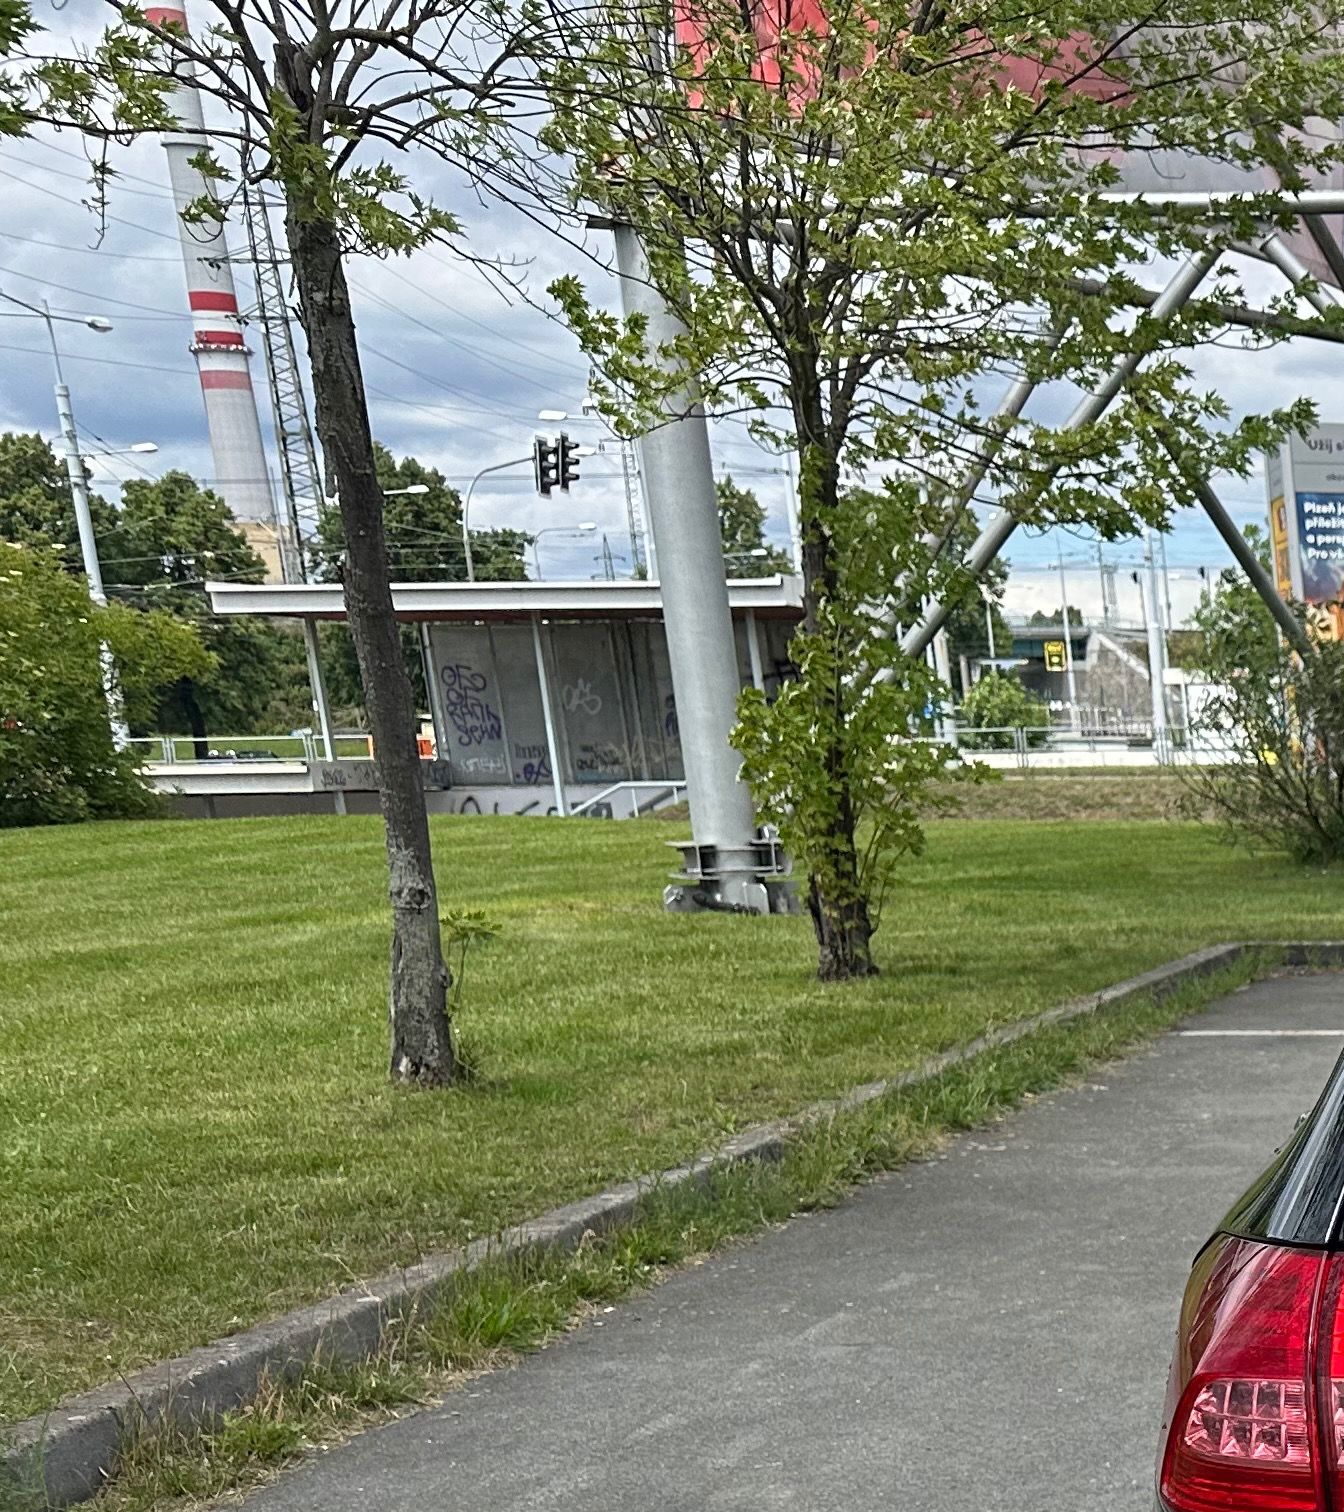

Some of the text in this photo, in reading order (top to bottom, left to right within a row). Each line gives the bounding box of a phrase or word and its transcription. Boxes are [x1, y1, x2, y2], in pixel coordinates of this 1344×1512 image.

[1303, 501, 1336, 515] Plzeň
[1306, 535, 1315, 544] a
[1308, 548, 1329, 561] Pro
